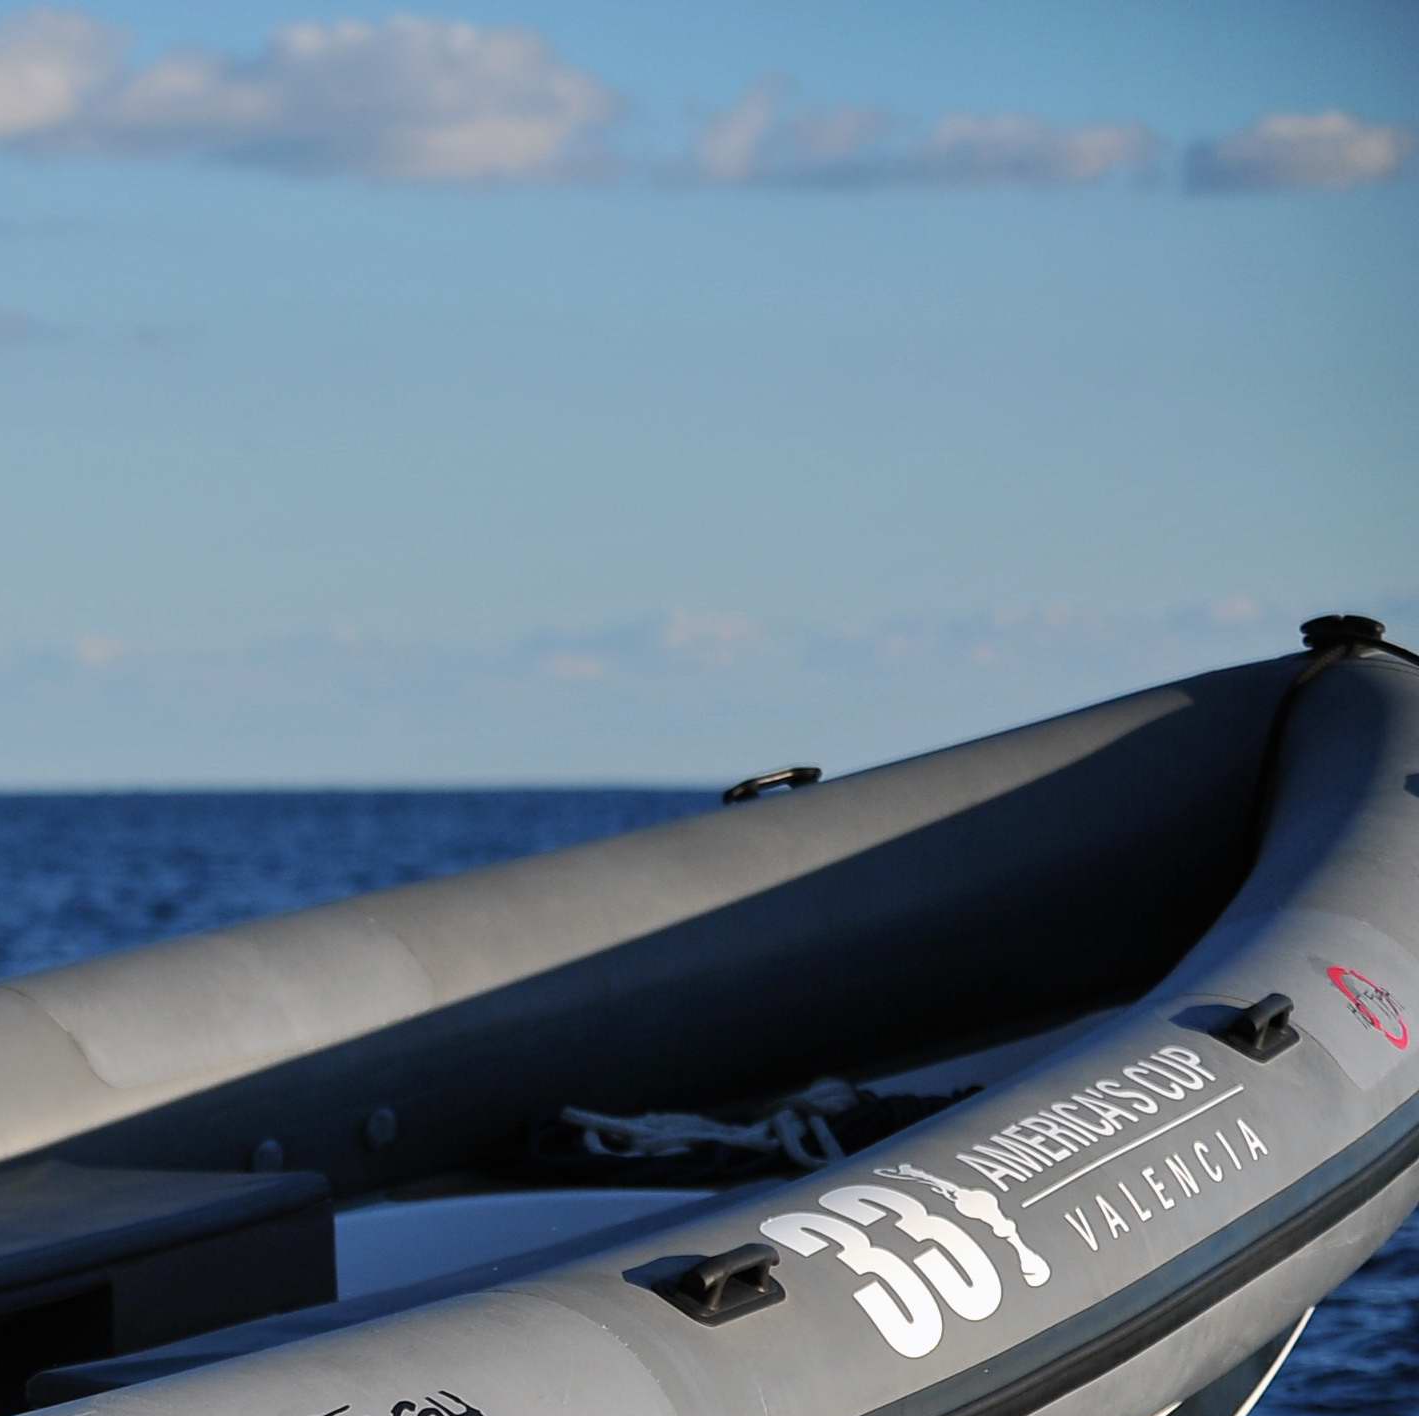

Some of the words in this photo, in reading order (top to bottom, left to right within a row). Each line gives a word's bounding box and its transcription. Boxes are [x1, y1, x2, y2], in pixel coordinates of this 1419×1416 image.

[956, 1064, 1161, 1193] AMERICA'S
[1122, 1043, 1219, 1102] CUP
[1064, 1117, 1269, 1253] VALENCIA
[759, 1184, 1003, 1360] 33
